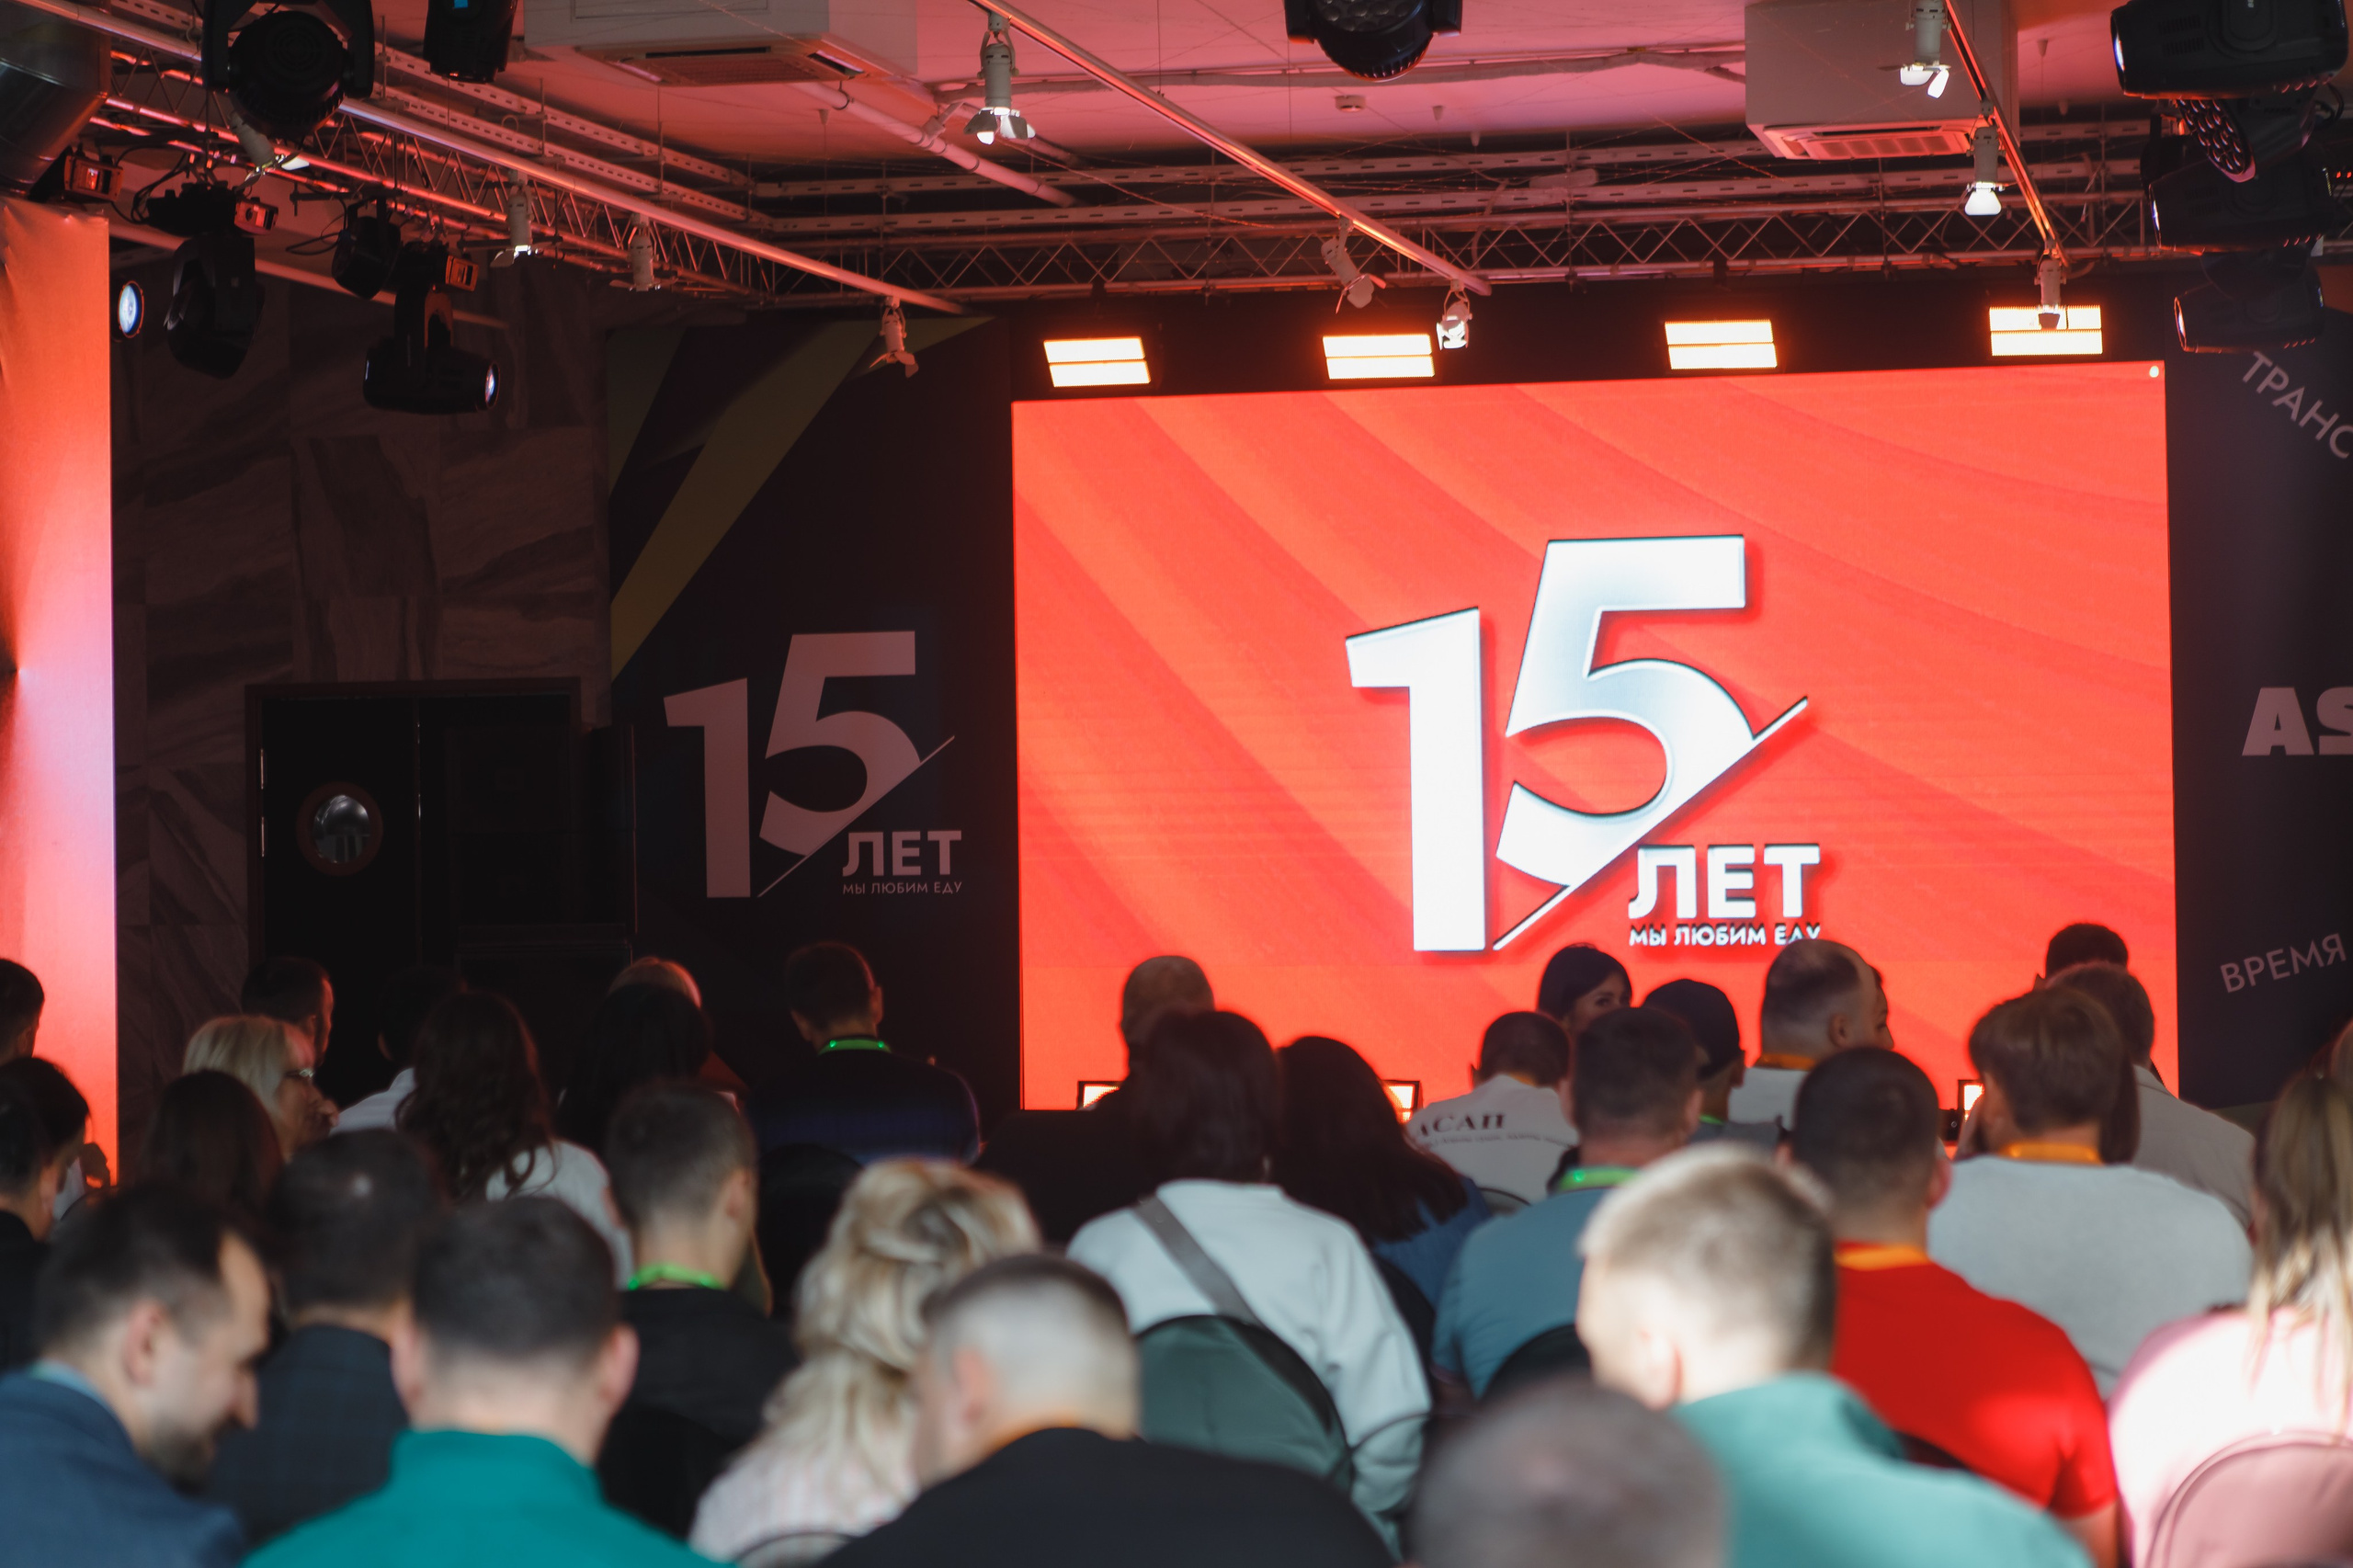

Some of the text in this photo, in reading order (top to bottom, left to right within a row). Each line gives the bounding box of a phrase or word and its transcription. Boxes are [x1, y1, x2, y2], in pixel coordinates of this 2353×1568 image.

[664, 631, 955, 899] 15
[1346, 534, 1810, 952] 15
[842, 830, 962, 877] ЛЕТ
[1628, 843, 1821, 919] ЛЕТ
[842, 881, 962, 894] МЫ ЛЮБИМ ЕДУ
[1629, 924, 1667, 947] МЫ
[1674, 923, 1767, 947] ЛЮБИМ
[2221, 933, 2347, 994] ВРЕМЯ
